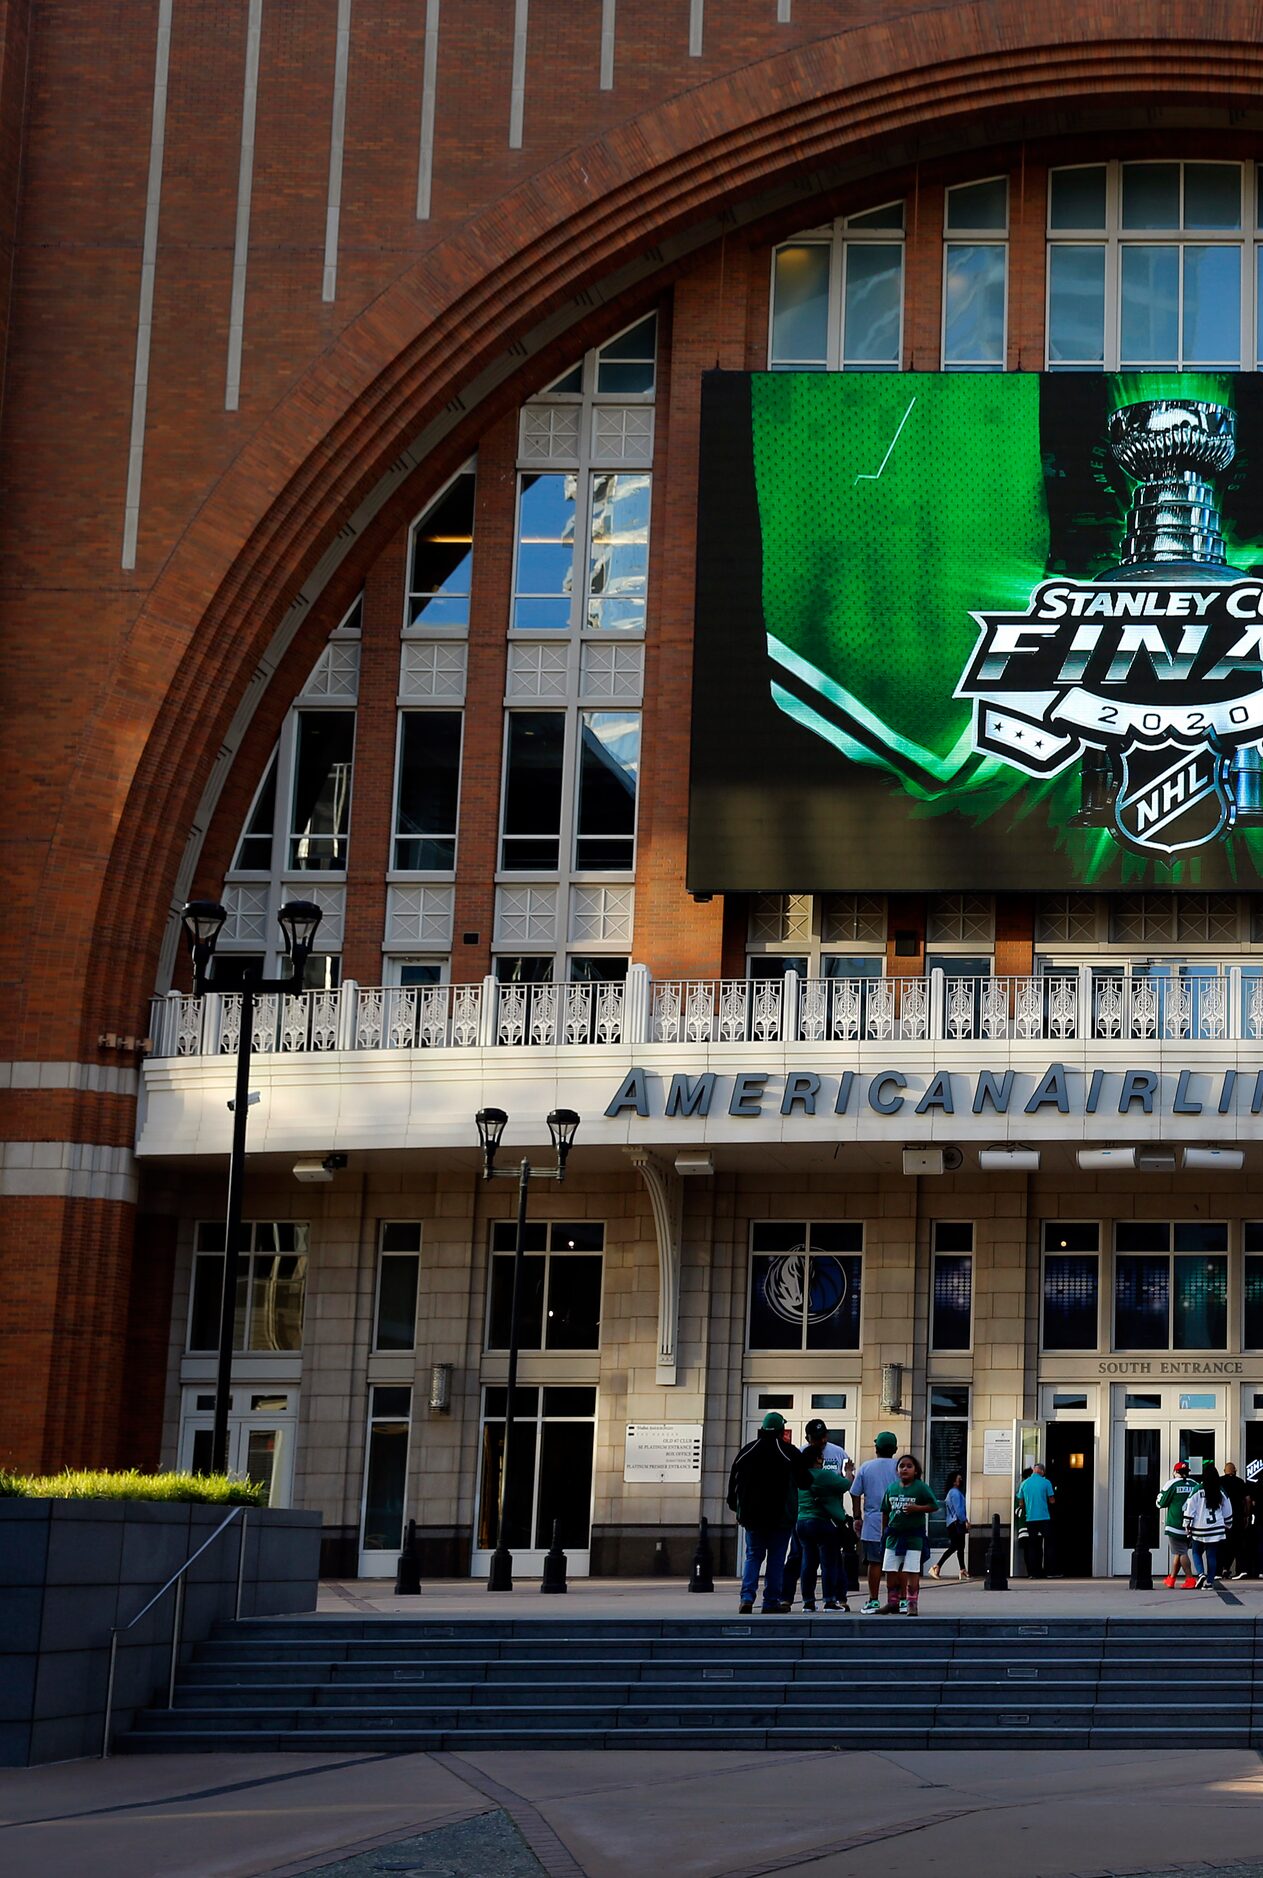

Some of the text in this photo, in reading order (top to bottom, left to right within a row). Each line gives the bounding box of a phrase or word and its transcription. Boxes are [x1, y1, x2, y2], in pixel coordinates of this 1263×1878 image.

[1039, 588, 1223, 618] STANLEY
[1097, 705, 1250, 732] 2020
[1135, 760, 1209, 832] NHL
[1098, 1362, 1244, 1374] SOUTH ENTRANCE
